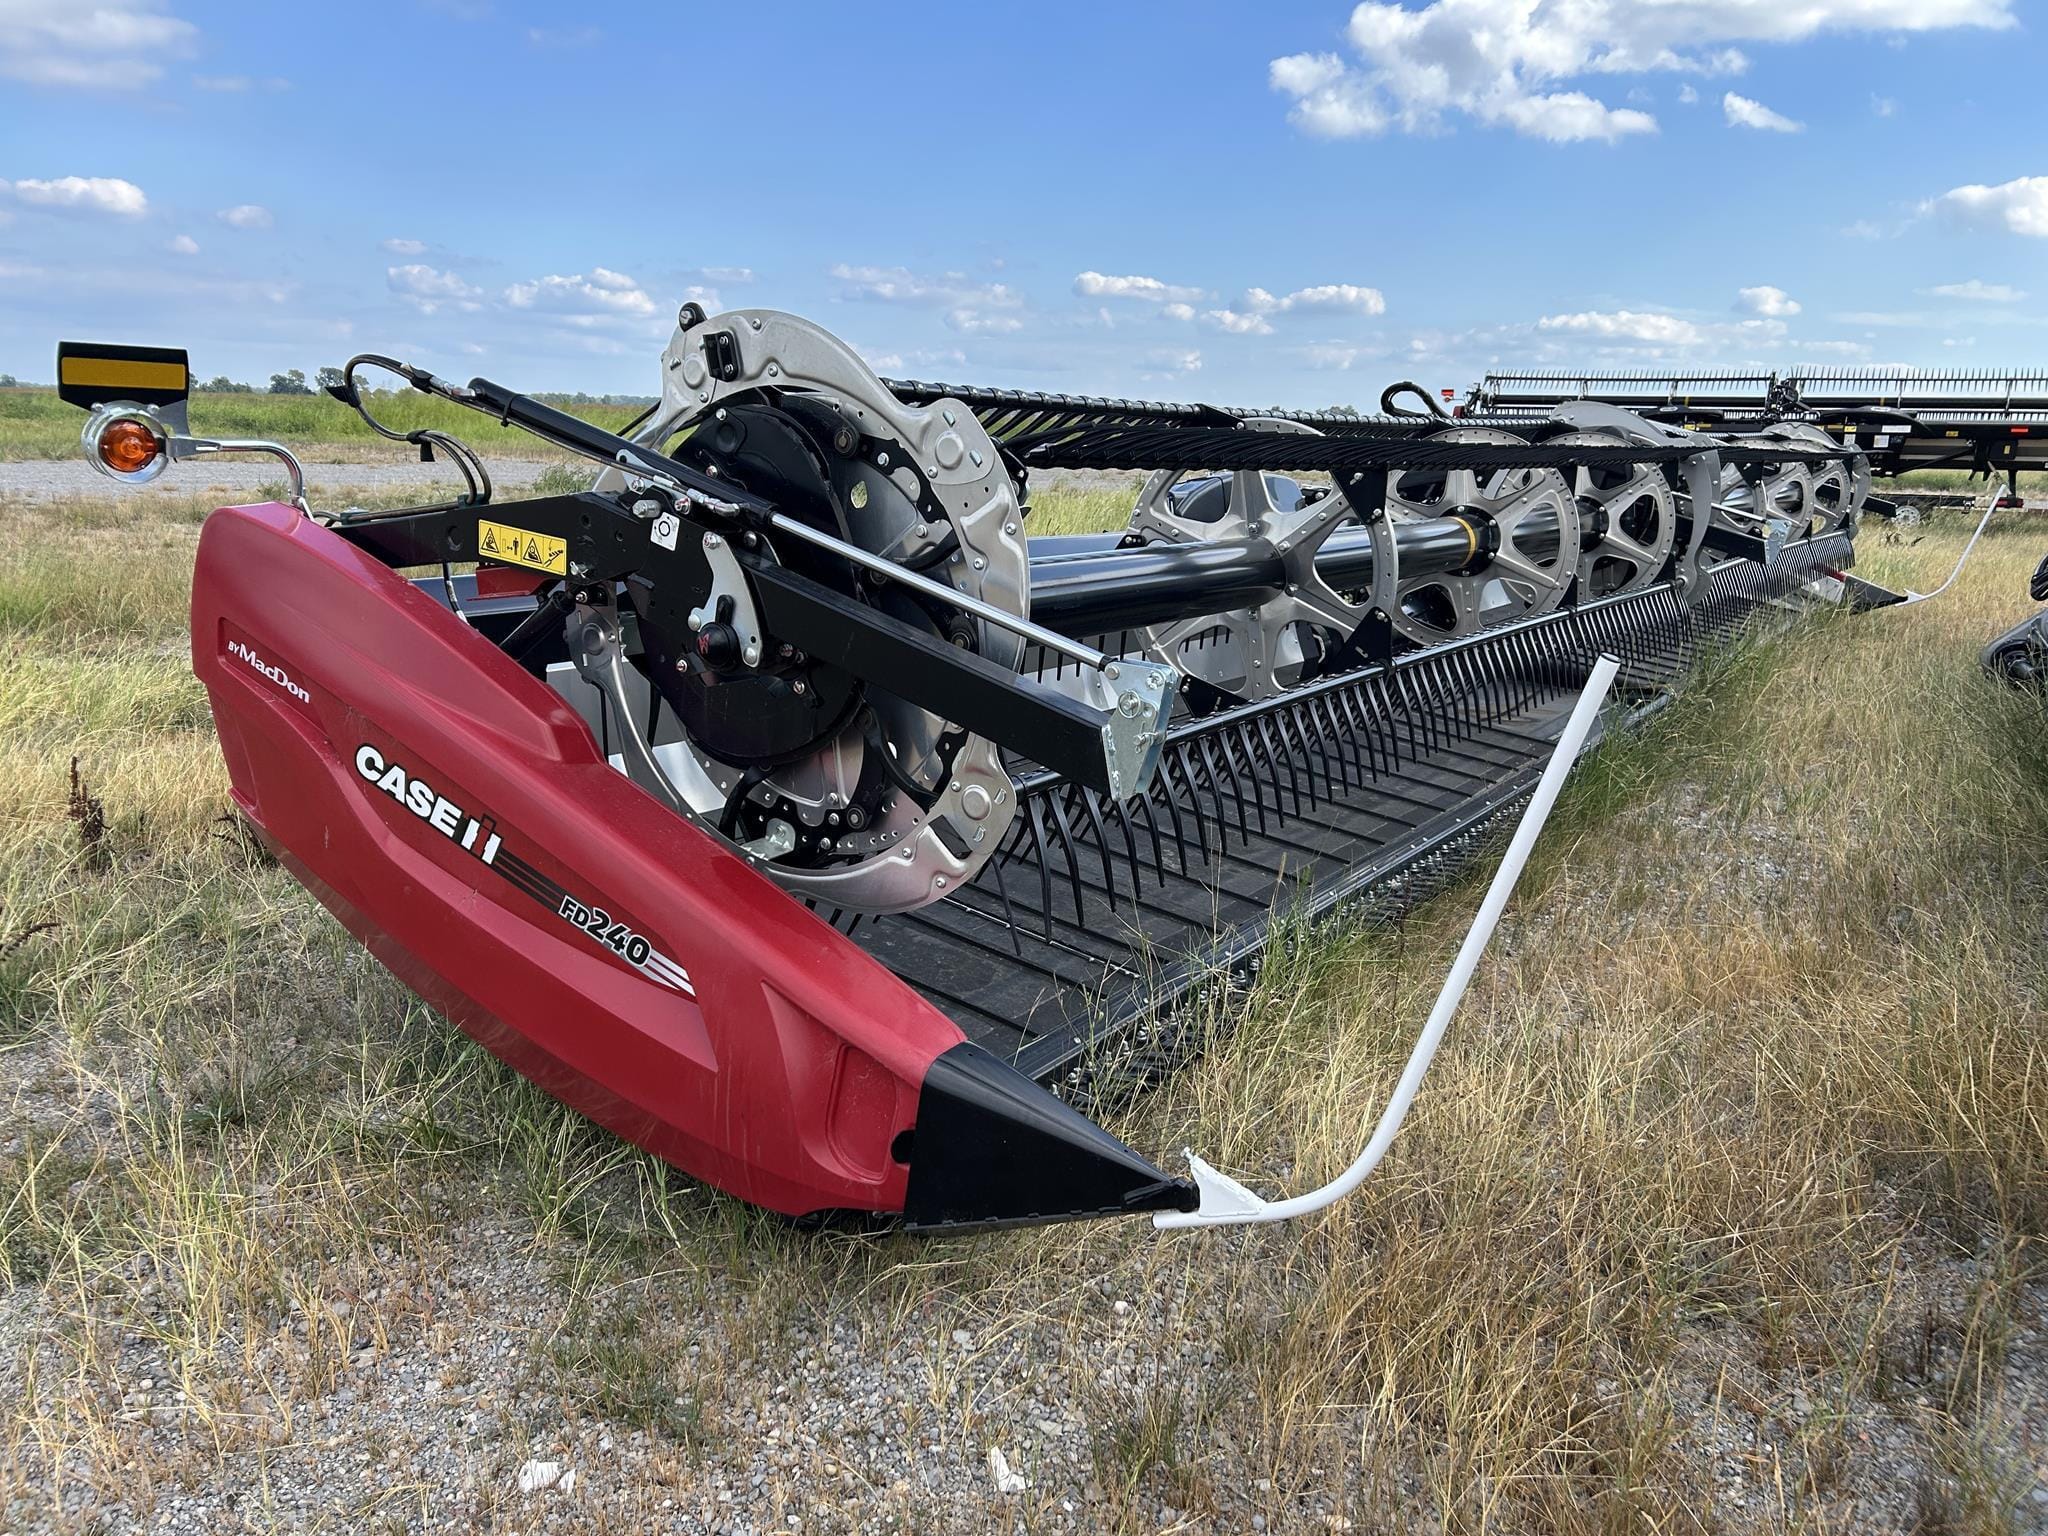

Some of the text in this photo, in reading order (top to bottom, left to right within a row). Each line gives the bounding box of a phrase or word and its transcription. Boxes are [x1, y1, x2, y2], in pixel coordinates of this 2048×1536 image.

[228, 641, 310, 703] BY MacDon
[355, 744, 463, 838] CASE
[558, 895, 652, 968] FD240
